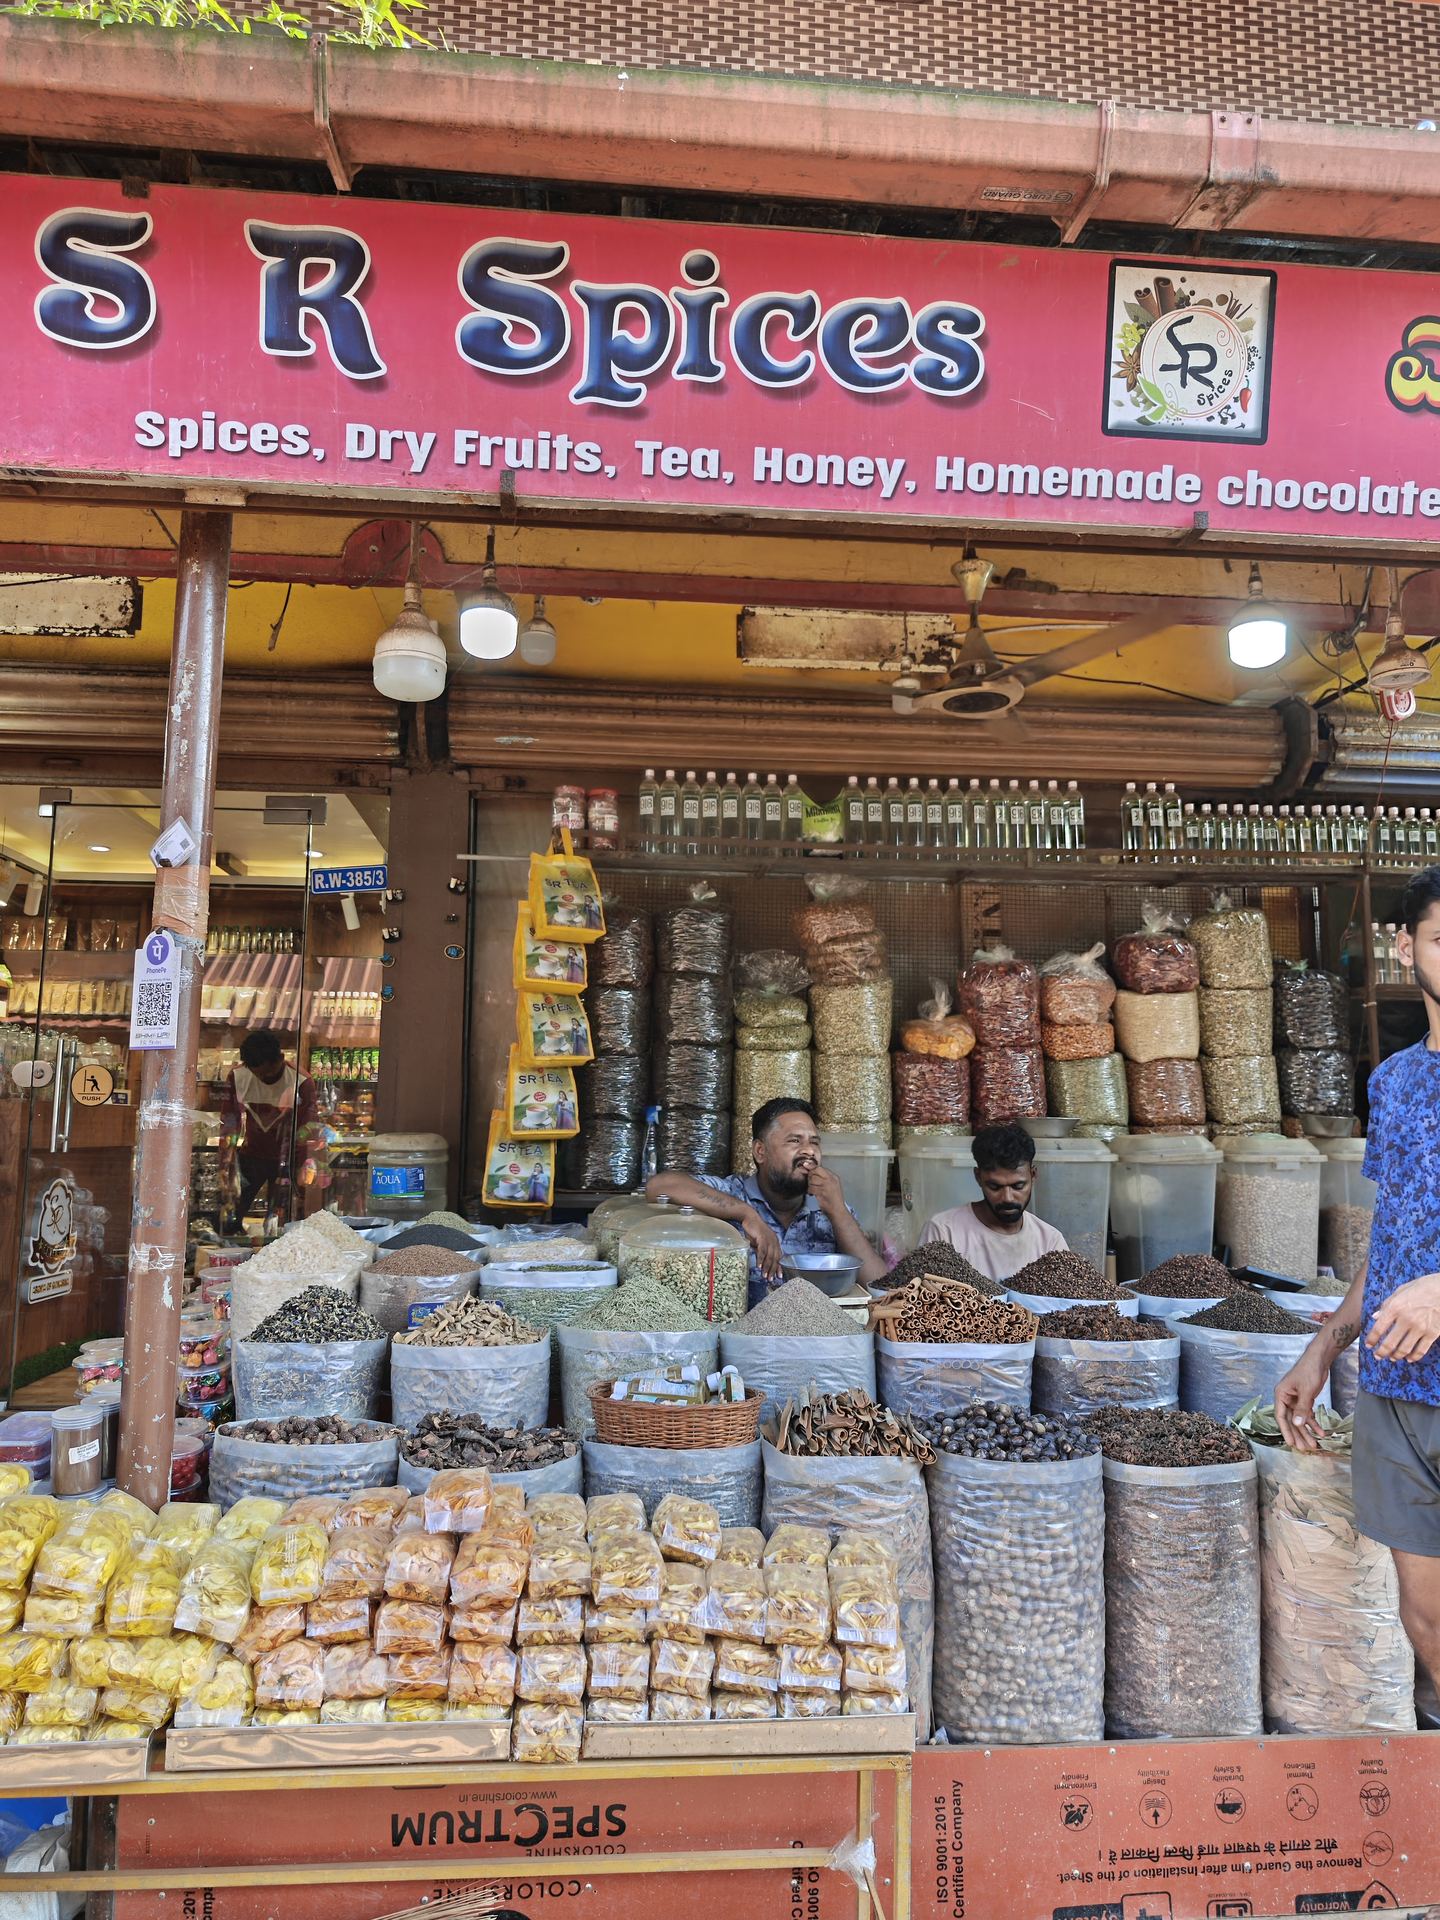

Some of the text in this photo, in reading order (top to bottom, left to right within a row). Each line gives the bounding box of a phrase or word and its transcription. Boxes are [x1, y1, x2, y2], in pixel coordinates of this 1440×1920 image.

[34, 206, 986, 407] S R Spices
[1196, 368, 1234, 407] Spices
[134, 410, 327, 462] Spices,
[344, 423, 437, 473] Dry
[453, 428, 618, 479] Fruits,
[634, 439, 736, 485] Tea,
[753, 446, 917, 498] Honey,
[935, 455, 1203, 503] Homemade
[314, 869, 385, 890] R.W-385/3
[518, 1072, 564, 1085] SR TEA
[498, 1142, 543, 1156] SR TEA
[1213, 1765, 1235, 1773] Safety
[1283, 1761, 1316, 1770] Efficiency
[1360, 1758, 1384, 1767] Quality
[1061, 1773, 1089, 1781] Friendly
[1142, 1777, 1166, 1786] Design
[1212, 1773, 1245, 1782] Durability
[1286, 1771, 1314, 1779] Thermal
[458, 1790, 558, 1803] www.colorshine.in
[391, 1803, 627, 1848] SPECTRUM
[934, 1795, 949, 1904] ISO 9001:2015
[951, 1779, 965, 1919] Certified Company
[1163, 1844, 1194, 1861] फिल्म
[1195, 1843, 1220, 1860] गार्ड
[1222, 1841, 1261, 1856] पश्चात
[1263, 1840, 1276, 1856] के
[1279, 1839, 1312, 1856] लगाने
[1314, 1838, 1339, 1854] शीट
[1107, 1848, 1118, 1866] दें
[1120, 1846, 1160, 1863] निकाल
[1201, 1862, 1226, 1876] after
[1255, 1861, 1291, 1873] Guard
[1295, 1859, 1313, 1870] the
[1316, 1857, 1362, 1869] Remove
[1056, 1870, 1093, 1884] Sheet.
[1097, 1869, 1115, 1882] the
[1117, 1868, 1130, 1880] of
[1133, 1865, 1198, 1878] Installation
[1300, 1900, 1350, 1913] Warranty
